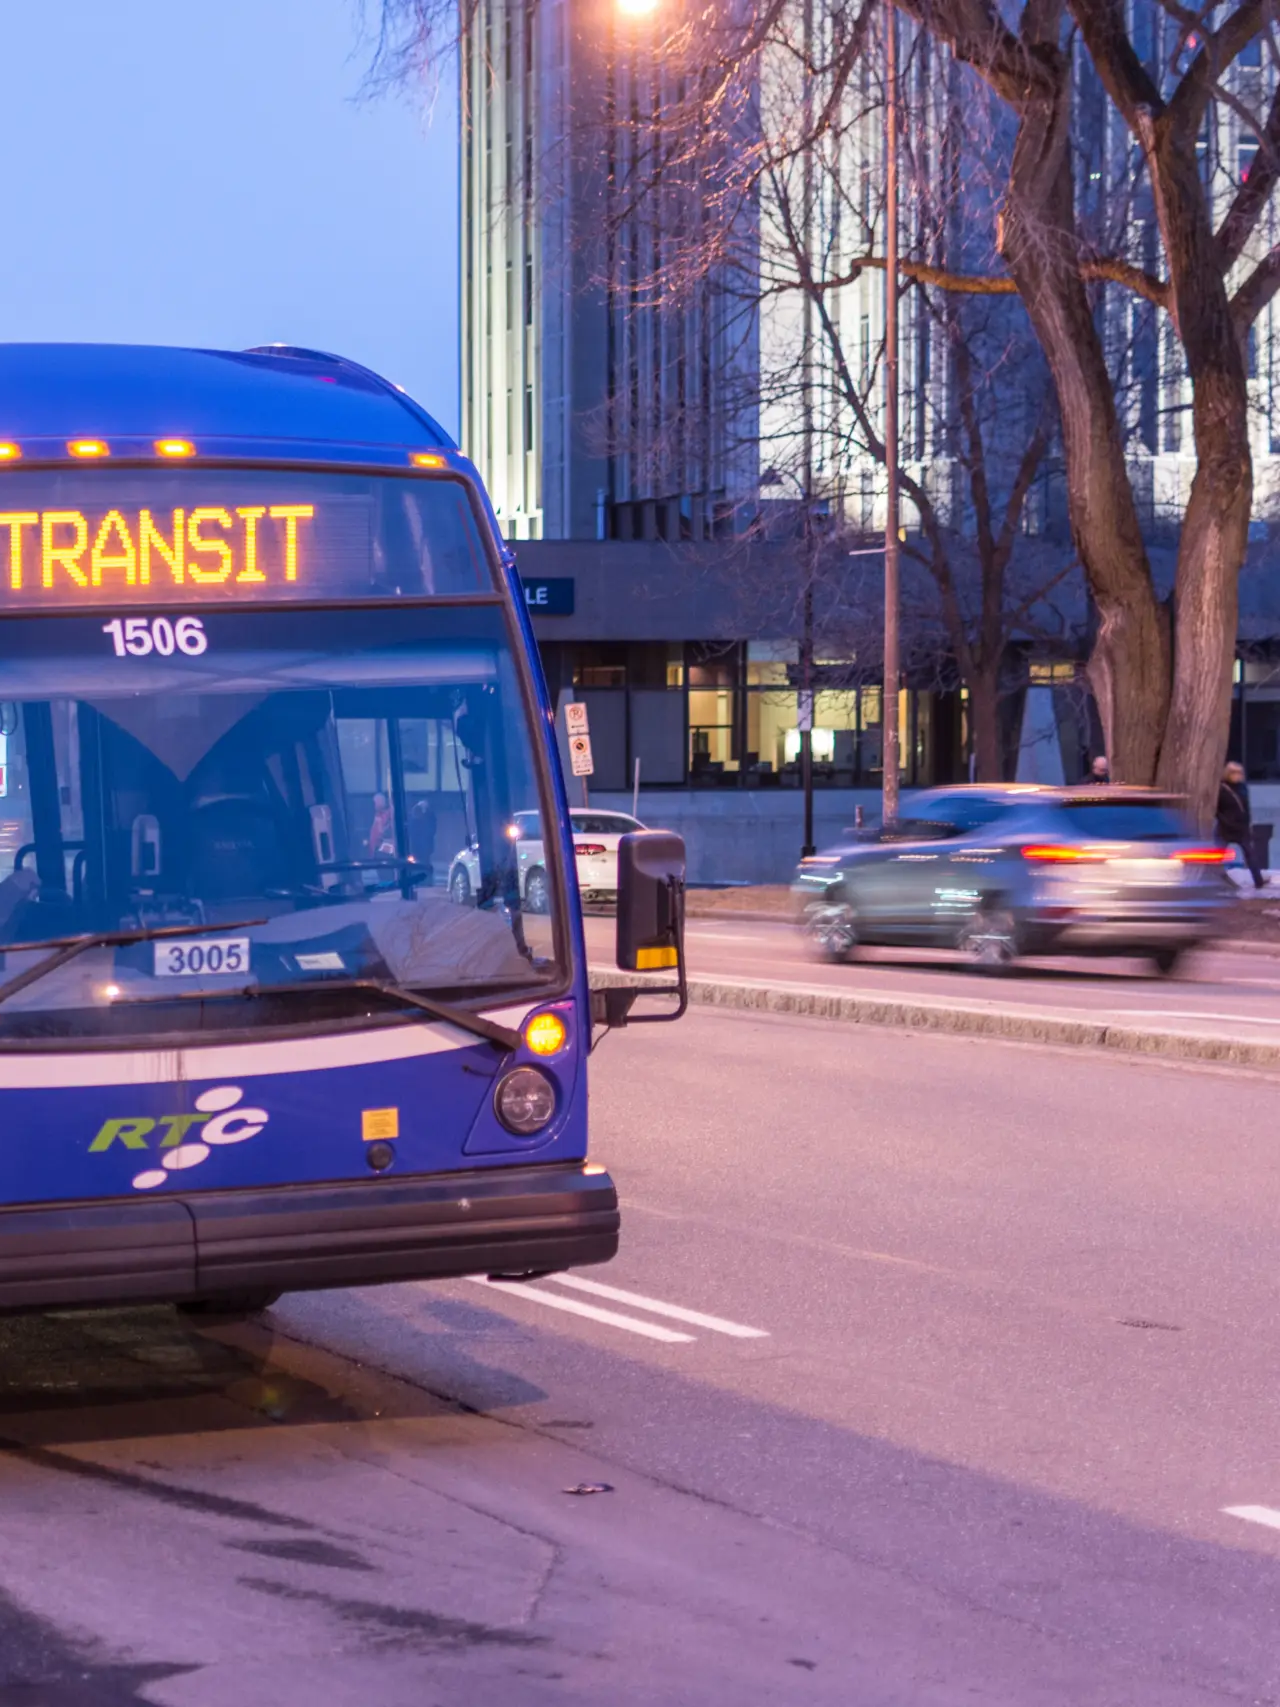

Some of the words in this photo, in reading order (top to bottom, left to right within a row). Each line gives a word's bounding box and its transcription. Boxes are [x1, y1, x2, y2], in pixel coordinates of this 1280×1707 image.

[102, 617, 208, 656] 1506
[169, 944, 242, 974] 3005
[88, 1107, 269, 1153] RTC
